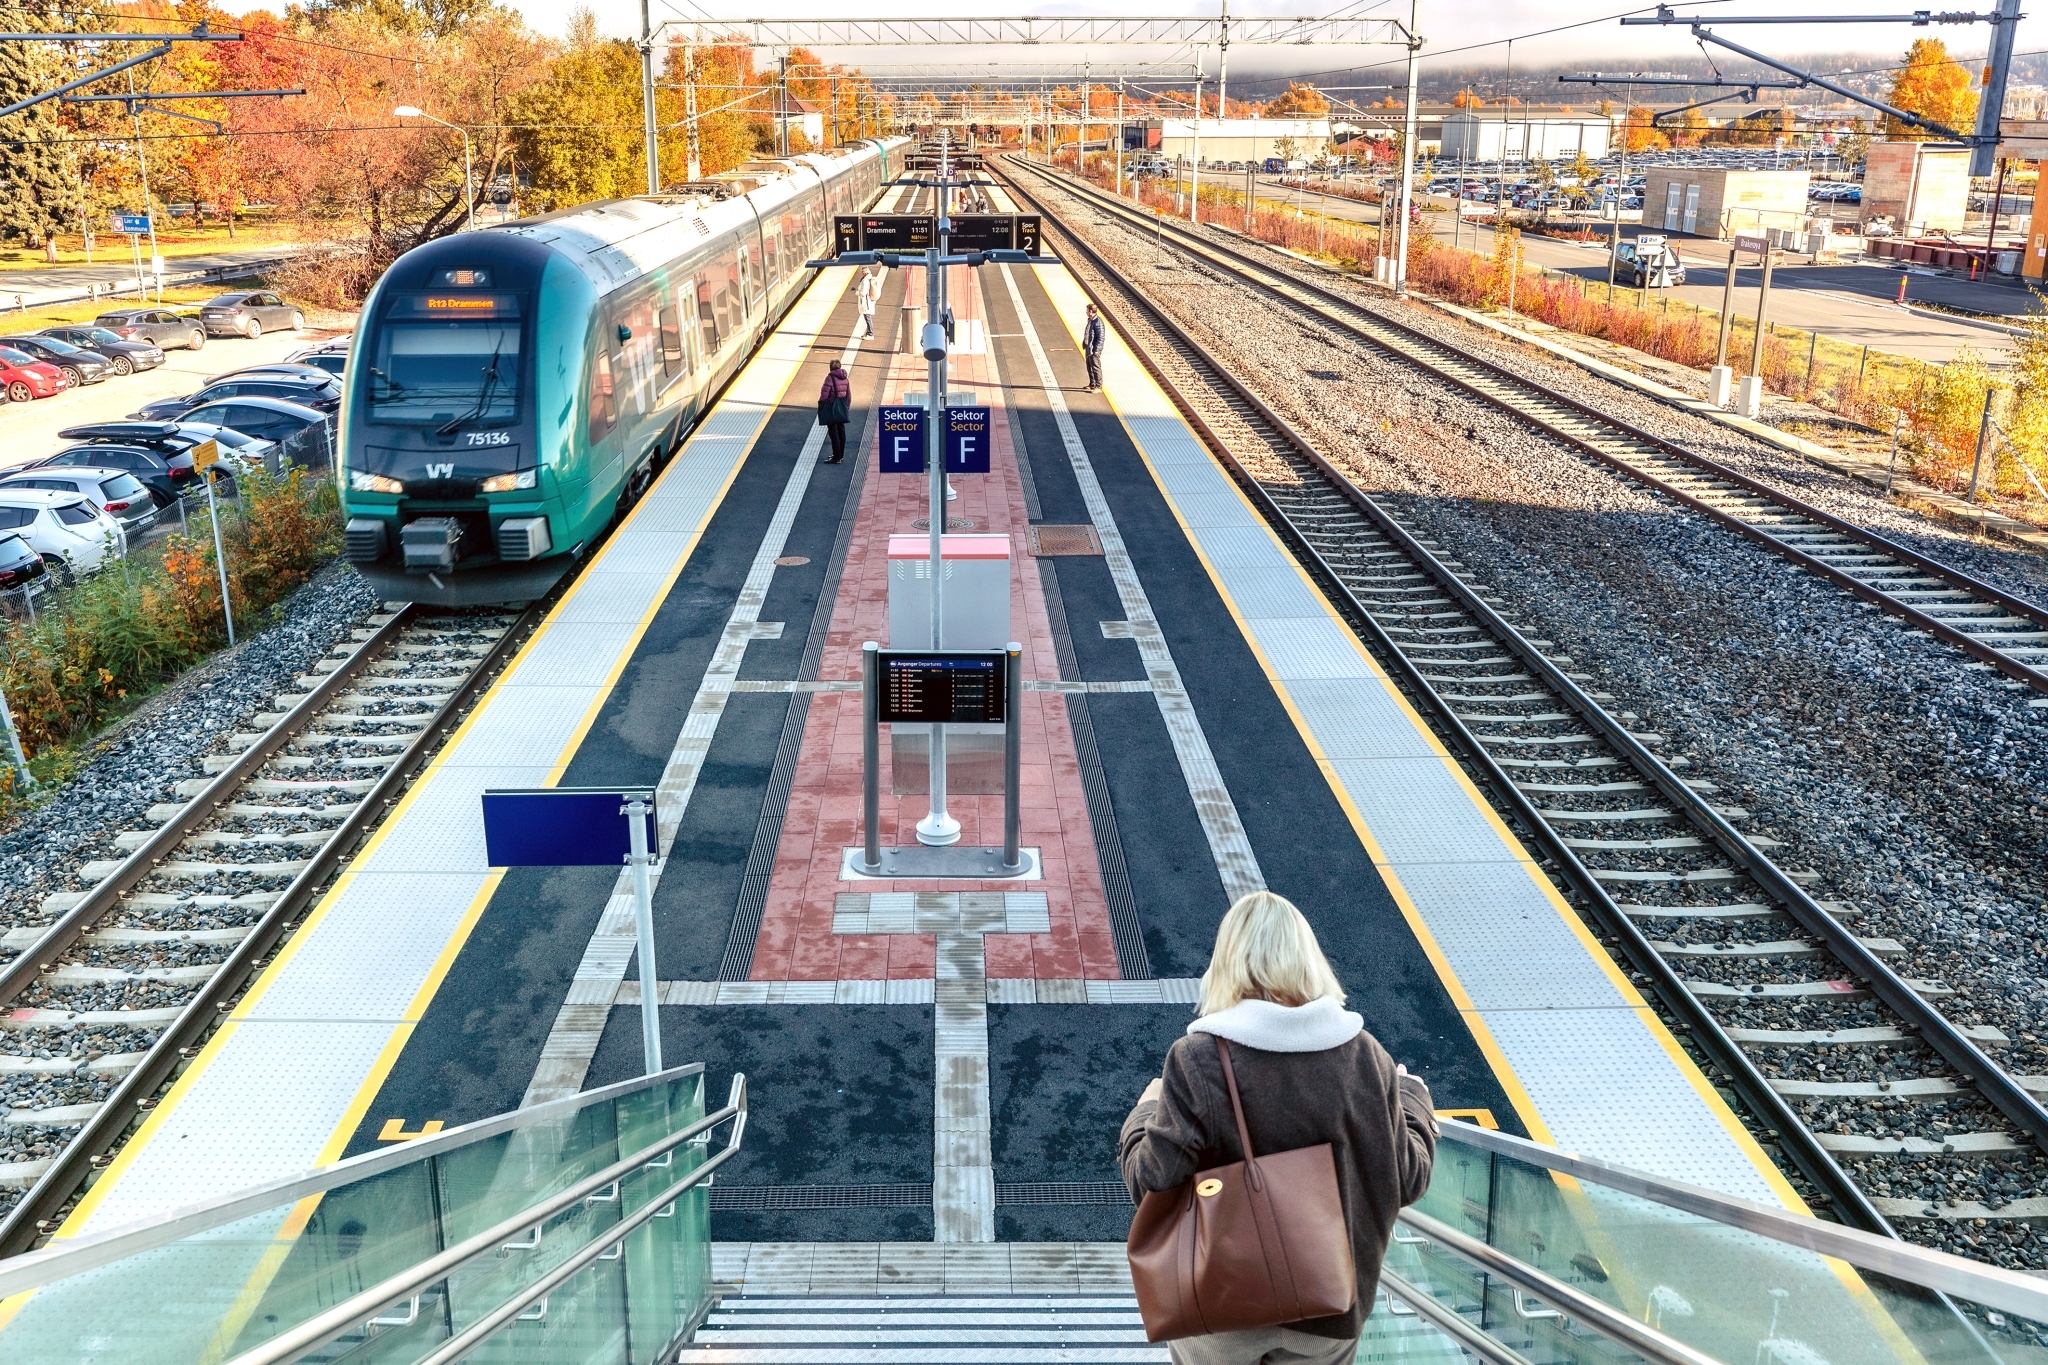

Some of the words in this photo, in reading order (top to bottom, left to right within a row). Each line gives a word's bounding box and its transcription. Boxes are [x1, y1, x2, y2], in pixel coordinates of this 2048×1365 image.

[843, 237, 850, 250] 1
[1024, 236, 1033, 250] 2
[448, 299, 494, 308] Drammen
[884, 410, 918, 420] Sektor
[951, 410, 984, 420] Sektor
[884, 422, 918, 431] Sector
[951, 422, 984, 431] Sector
[466, 432, 510, 445] 75136
[894, 437, 909, 463] F
[960, 437, 976, 463] F
